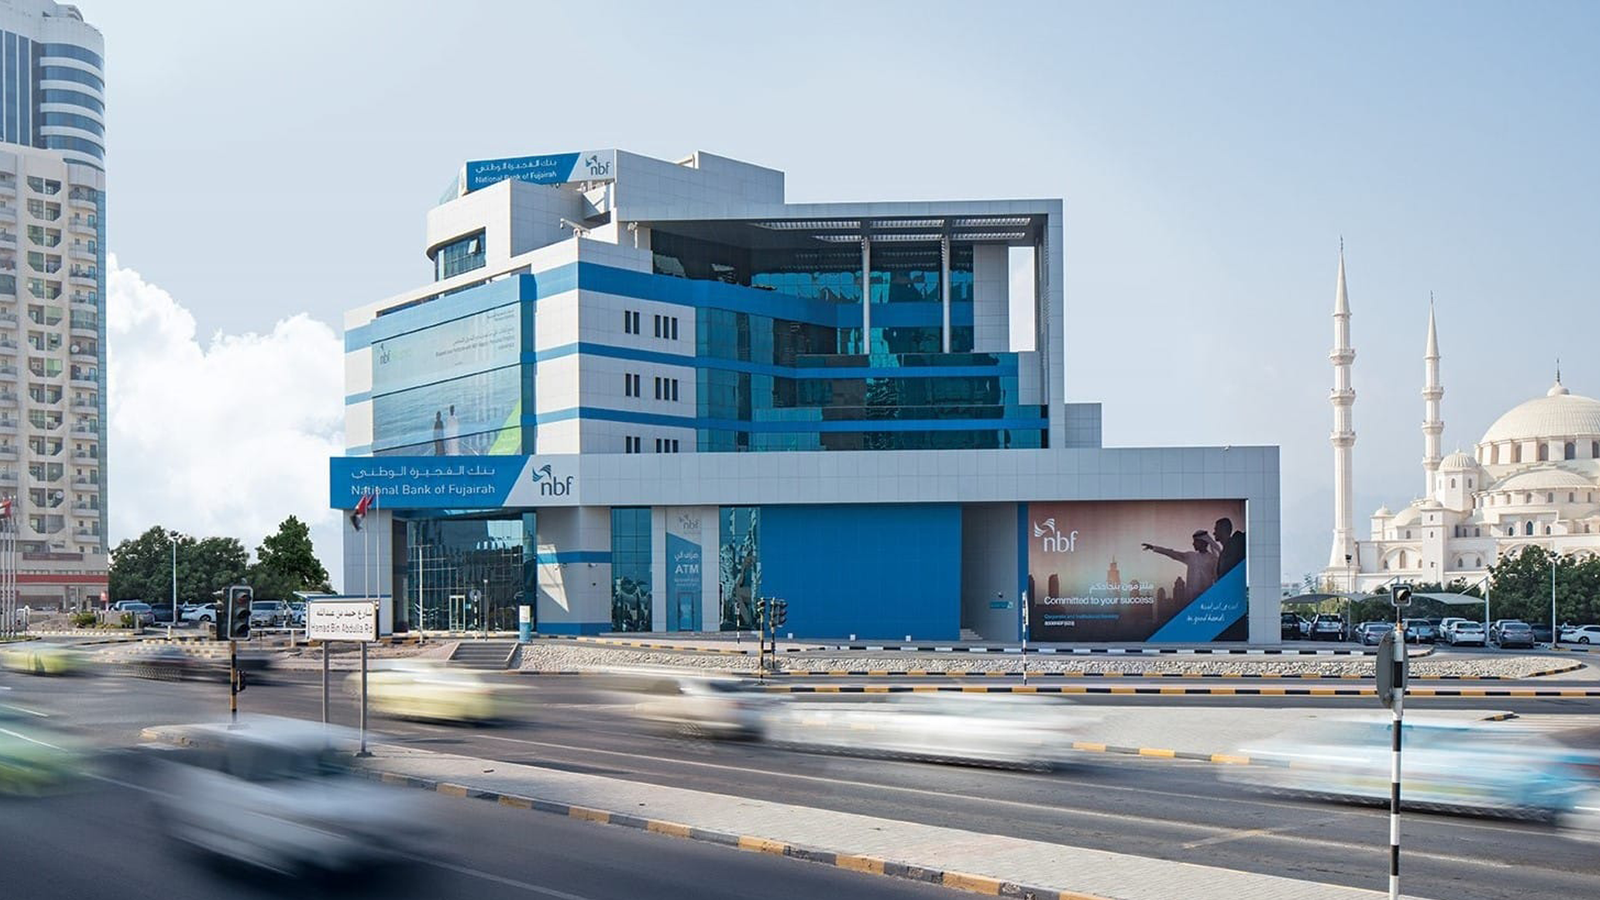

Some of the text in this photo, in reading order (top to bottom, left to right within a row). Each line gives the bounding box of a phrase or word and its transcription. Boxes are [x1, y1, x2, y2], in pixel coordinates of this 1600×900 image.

[475, 159, 557, 173] بنك الفجيرة الوطني
[590, 161, 611, 176] nbf
[475, 175, 503, 183] National
[530, 171, 557, 180] Fujairah
[379, 350, 391, 365] nbf
[351, 465, 496, 479] بنك الفجيرة الوطني
[351, 484, 496, 498] National Bank of Fujairah
[540, 475, 574, 498] nbf
[683, 519, 699, 530] nbf
[1043, 530, 1079, 553] nbf
[675, 564, 699, 574] ATM
[1089, 582, 1154, 595] ملتزمون بنجاحكم
[1043, 596, 1154, 607] Committed to your success
[358, 606, 373, 620] شارع
[1194, 613, 1208, 625] good
[311, 624, 330, 633] Hamad
[331, 623, 341, 633] Bin
